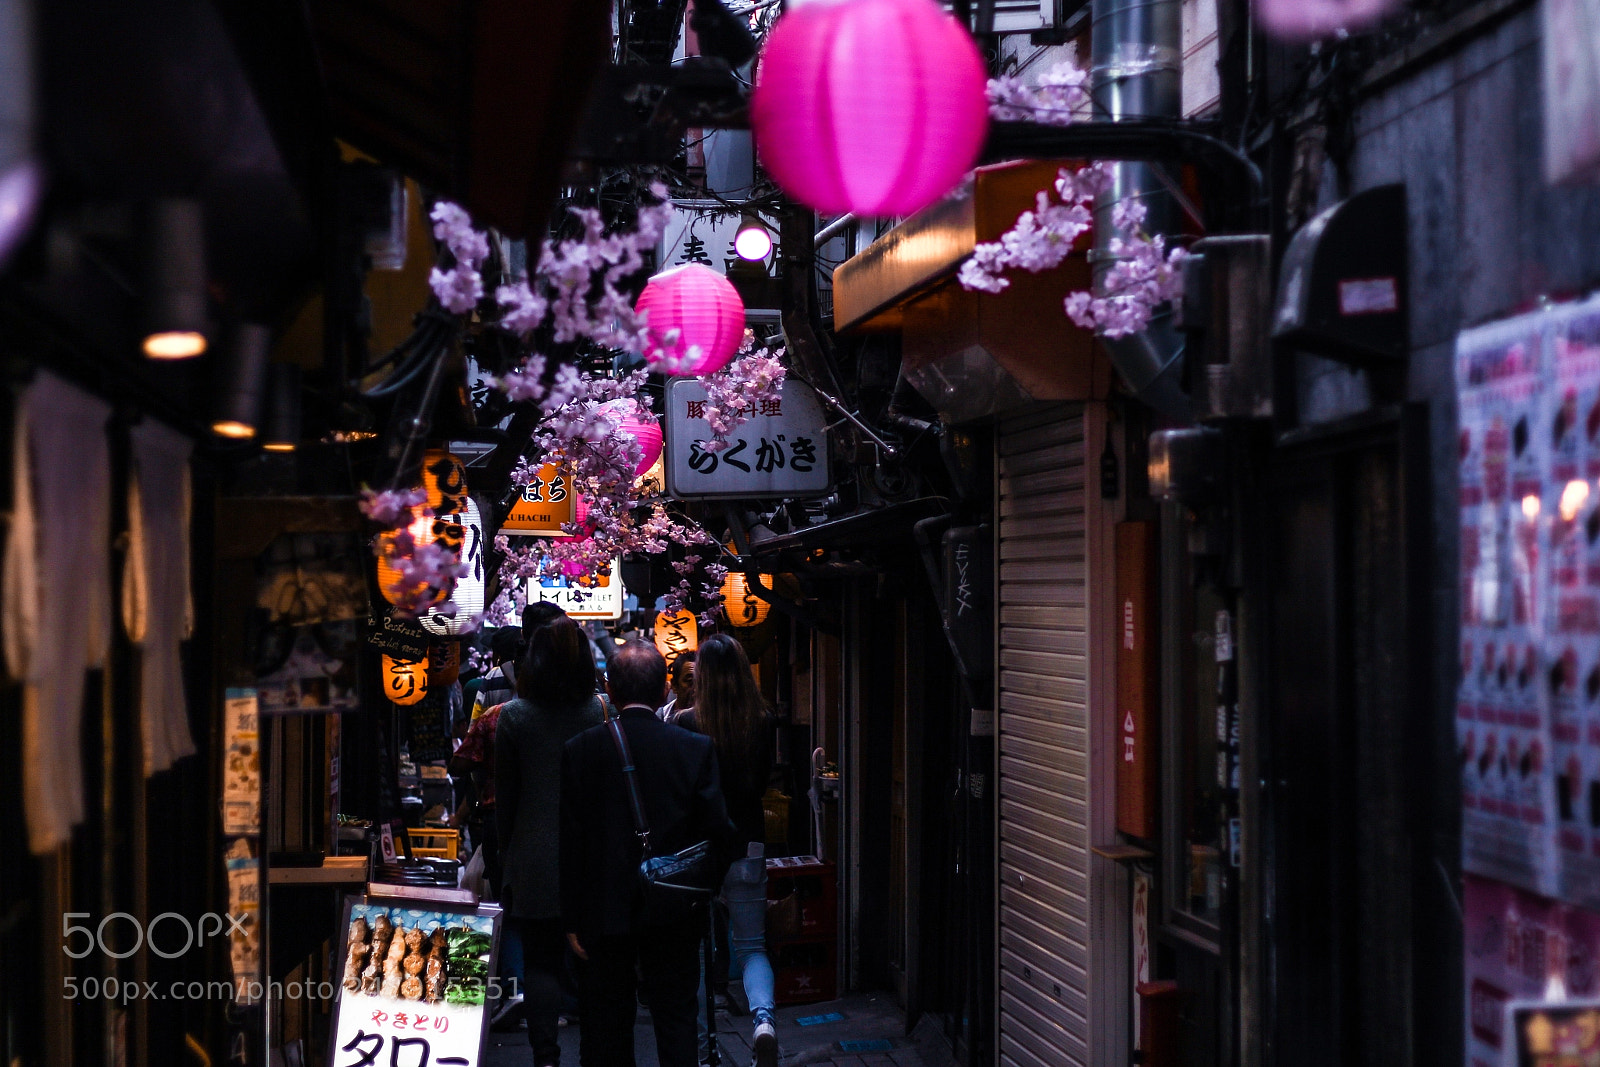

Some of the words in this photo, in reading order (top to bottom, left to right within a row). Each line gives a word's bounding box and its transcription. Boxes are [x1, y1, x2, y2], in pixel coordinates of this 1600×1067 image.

[686, 399, 783, 419] 豚料理
[688, 434, 817, 475] らくがき
[540, 590, 577, 603] トイレ
[371, 1009, 449, 1033] やきとり
[341, 1029, 470, 1067] タロー
